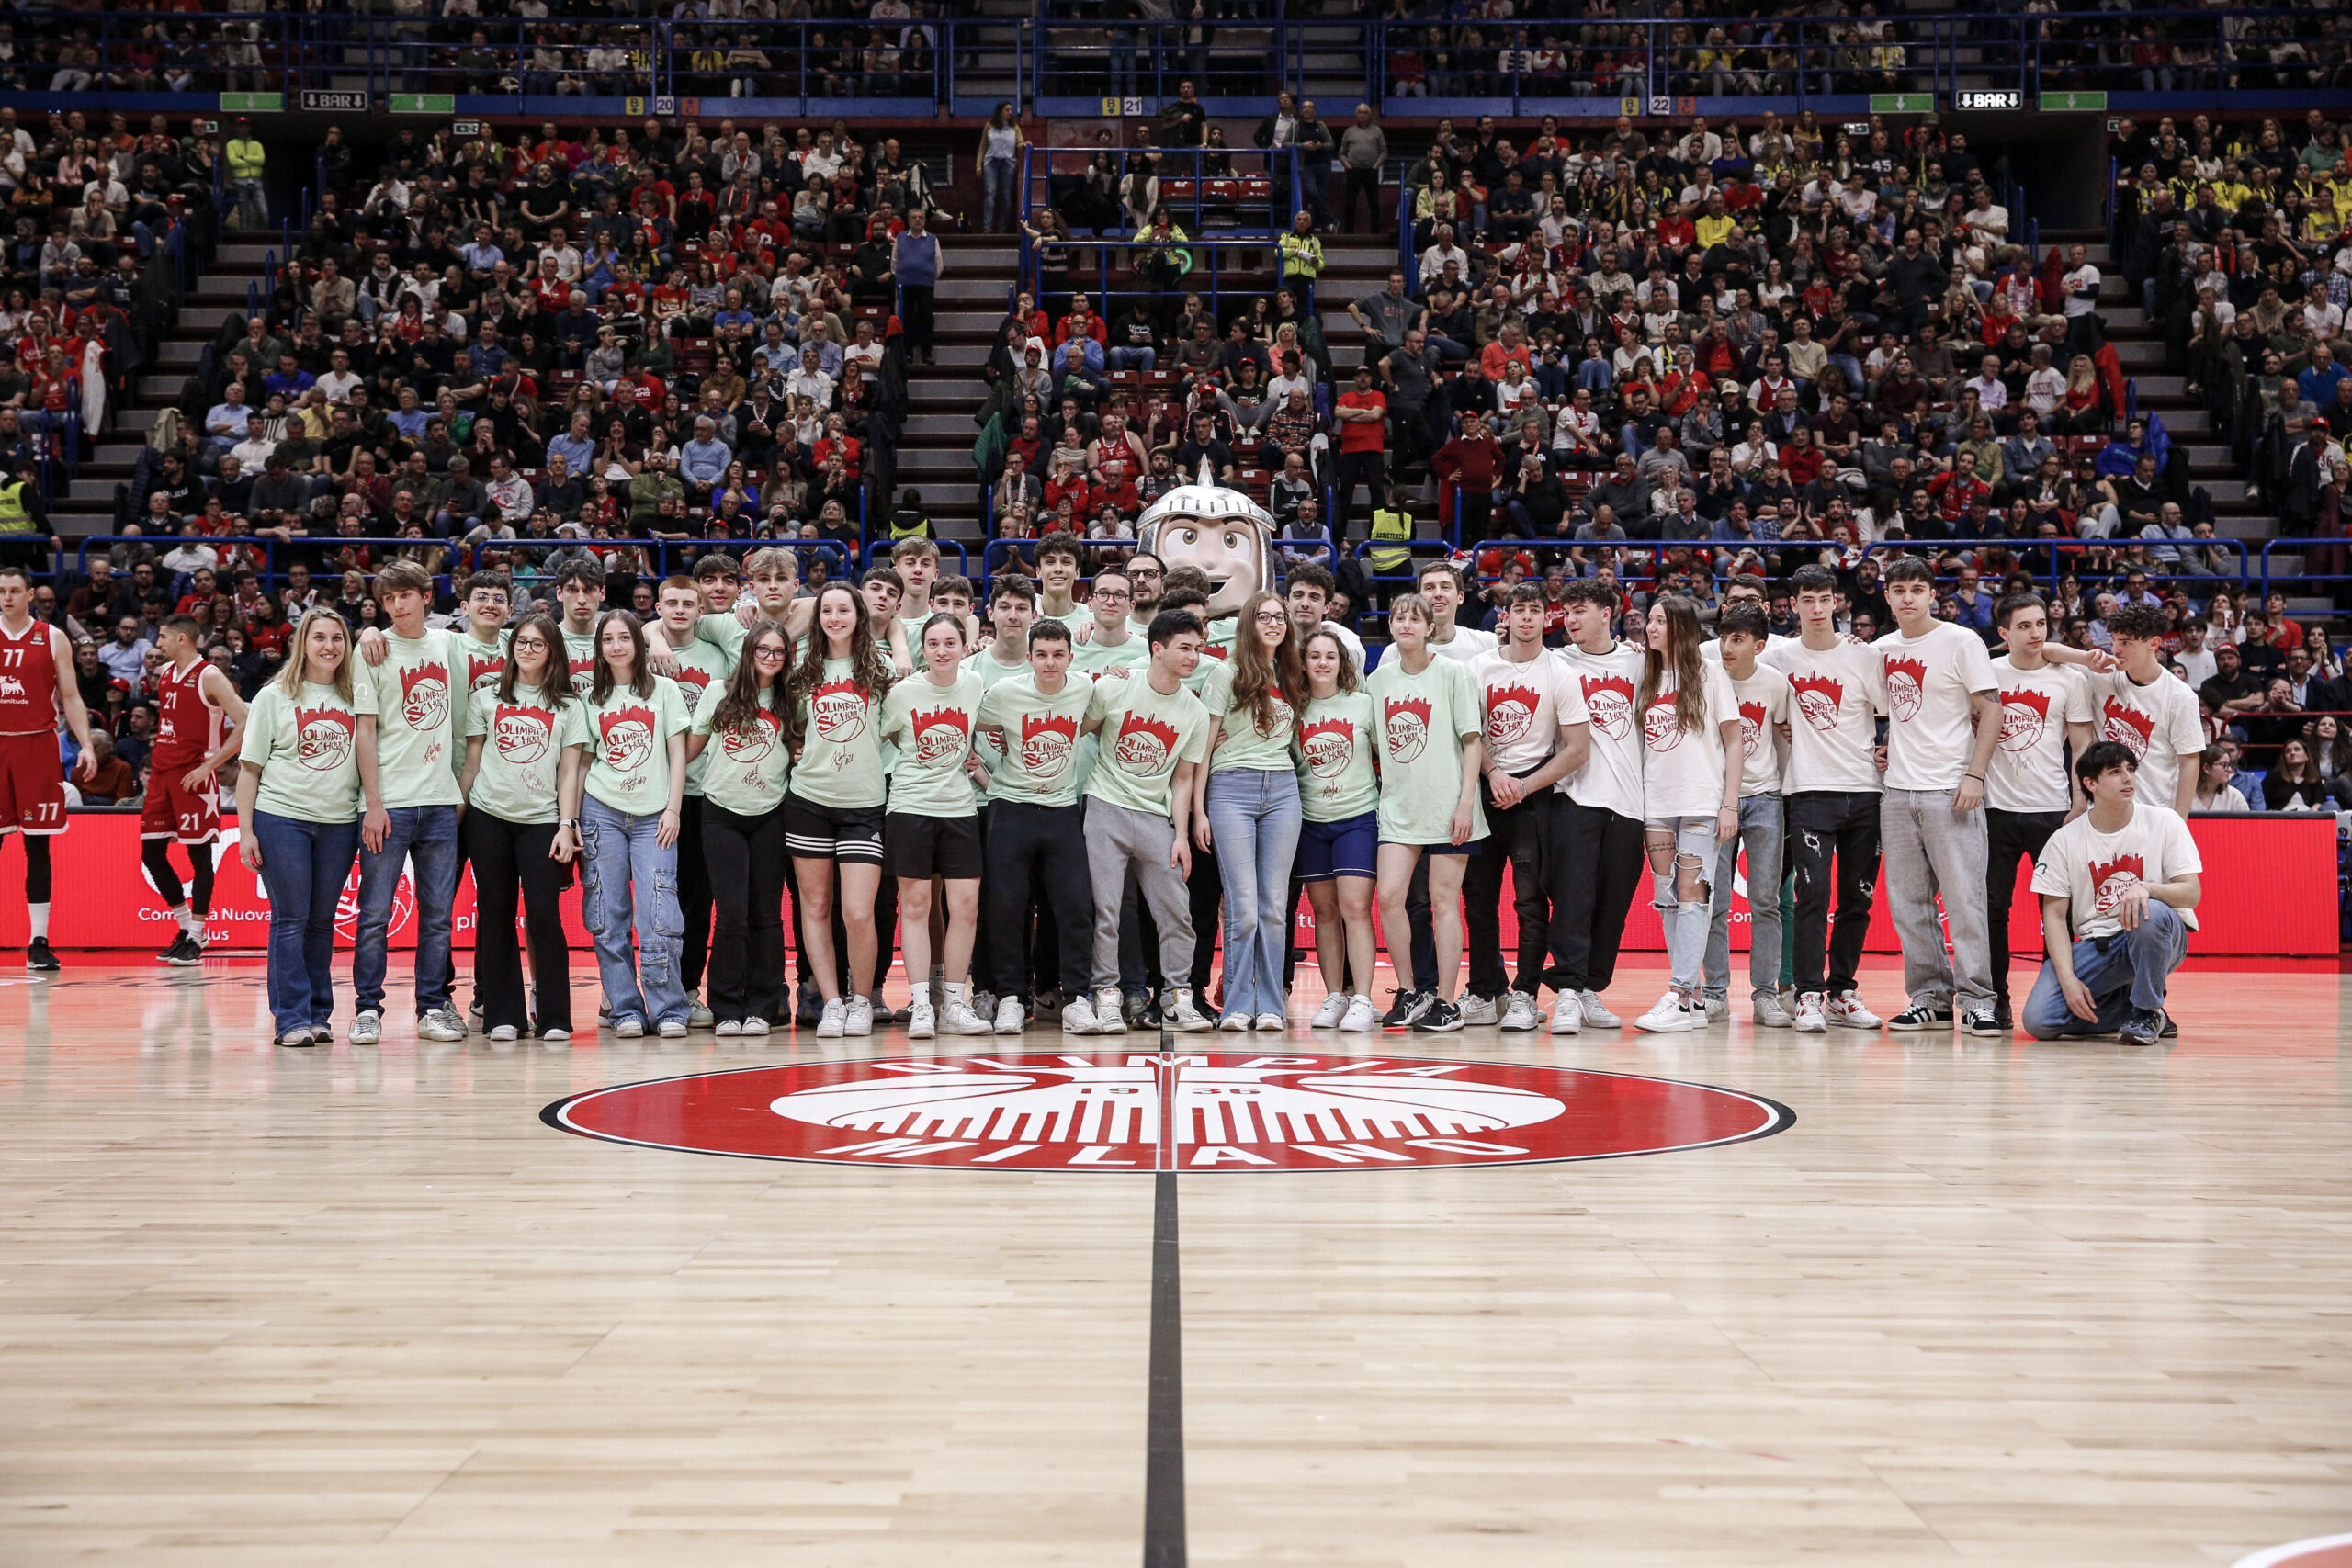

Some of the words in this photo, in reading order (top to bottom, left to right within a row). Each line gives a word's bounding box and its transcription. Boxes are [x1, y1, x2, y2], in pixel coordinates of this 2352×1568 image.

[319, 94, 351, 107] BAR
[630, 98, 639, 107] B
[657, 98, 673, 111] 20
[1107, 98, 1115, 107] B
[1125, 100, 1140, 112] 21
[1653, 98, 1669, 111] 22
[1973, 94, 2006, 107] BAR
[1871, 159, 1892, 173] 45
[3, 648, 25, 668] 77
[0, 697, 29, 705] lenitude
[164, 691, 177, 710] 21
[407, 691, 441, 705] OLIMPIA
[406, 699, 443, 721] SCHOOL
[816, 701, 857, 713] OLIMPIA
[1588, 699, 1624, 712] OLIMPIA
[817, 711, 859, 731] SCHOOL
[1591, 711, 1627, 724] SCHOOL
[2004, 713, 2034, 725] LIMPIA
[302, 729, 343, 741] OLIMPIA
[498, 721, 542, 736] OLIMPIA
[1388, 723, 1419, 735] OLIMPIA
[498, 734, 542, 750] SCHOOL
[608, 732, 644, 746] OLIMPIA
[920, 736, 958, 747] OLIMPIA
[1122, 736, 1159, 756] OLIMPIA
[1389, 733, 1419, 752] SCHOOL
[300, 740, 343, 757] SCHOOL
[608, 740, 645, 761] SCHOOL
[918, 742, 958, 760] SCHOOL
[1026, 741, 1064, 752] OLIMPIA
[1304, 742, 1344, 756] OLIMPIA
[1116, 746, 1158, 763] SCHOOL
[38, 802, 59, 822] 77
[180, 813, 199, 832] 21
[221, 908, 272, 921] Nuova
[869, 1055, 1471, 1077] OLIMPIA
[814, 1137, 1531, 1168] MILANO
